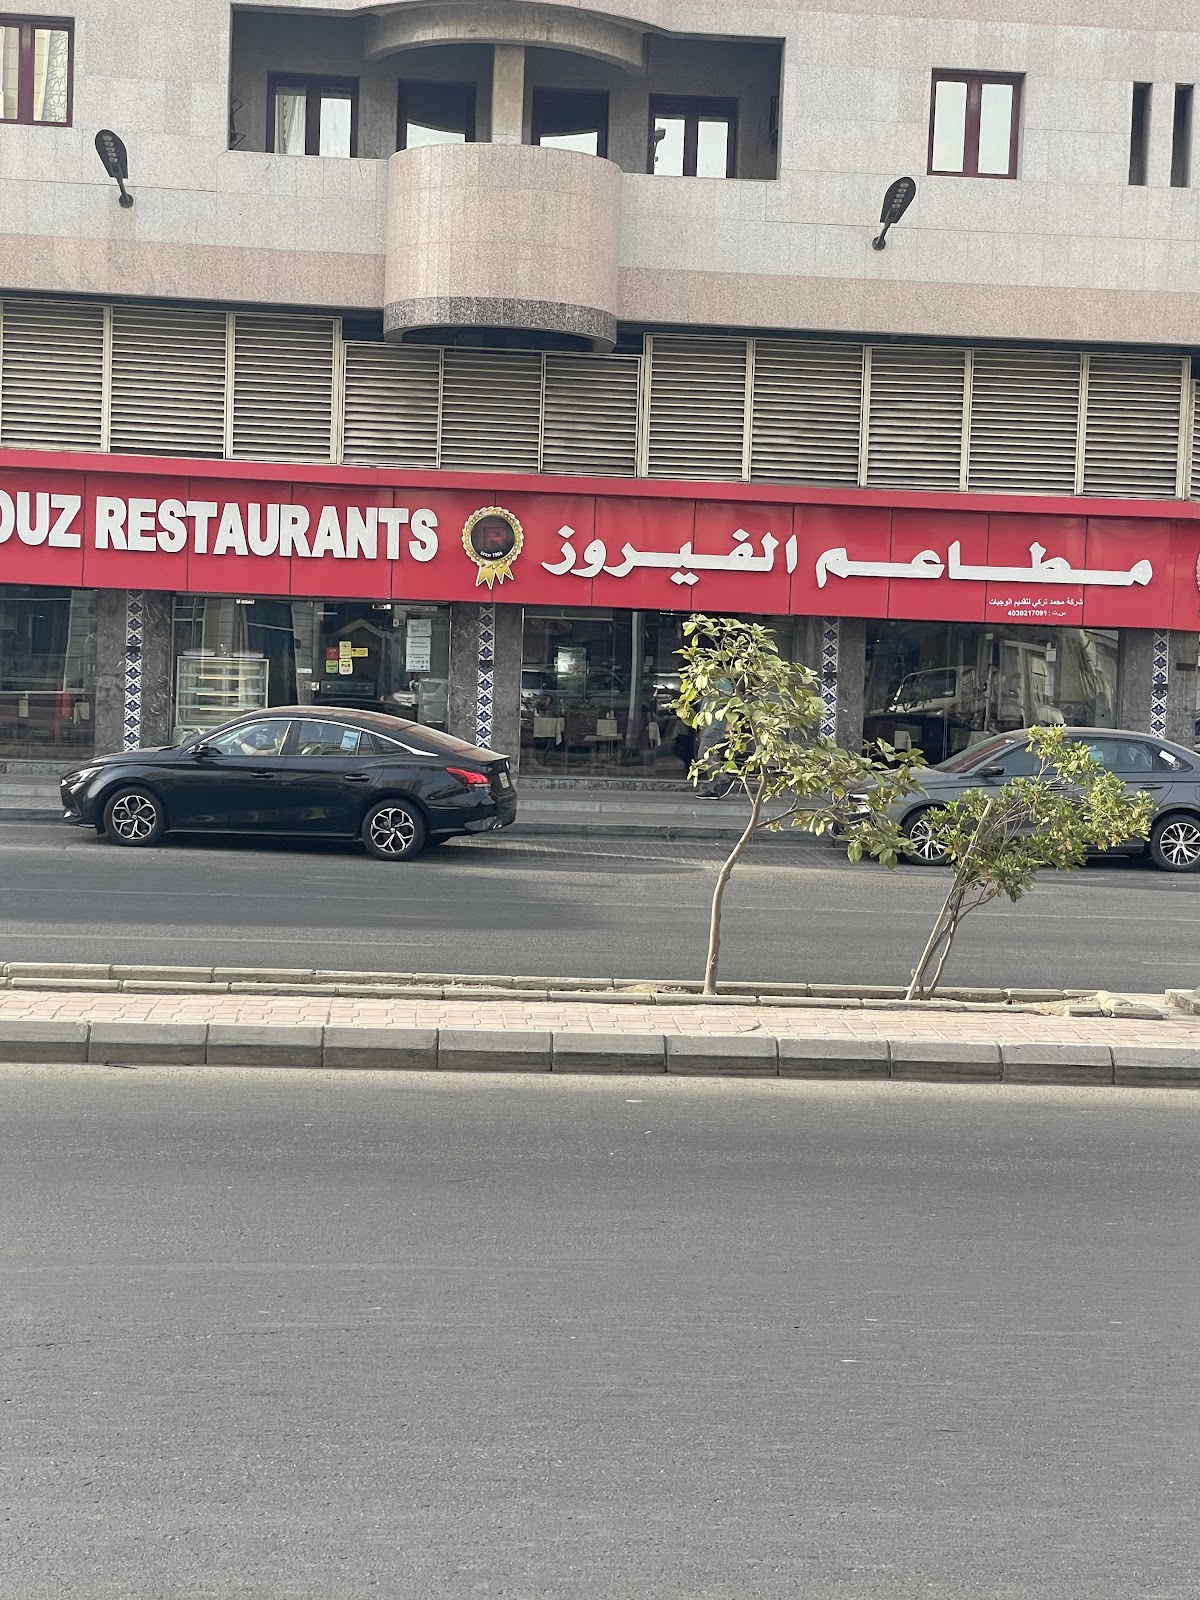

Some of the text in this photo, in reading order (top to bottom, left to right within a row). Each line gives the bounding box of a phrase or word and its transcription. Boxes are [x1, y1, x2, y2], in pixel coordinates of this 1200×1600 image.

[95, 496, 439, 562] RESTAURANTS
[541, 525, 1152, 588] مطاعم الفيروز
[989, 598, 1012, 607] الوجبات
[1013, 598, 1031, 607] لتقديم
[1032, 598, 1048, 608] تركي
[1066, 597, 1083, 607] شركة
[1007, 609, 1047, 617] 4030217091
